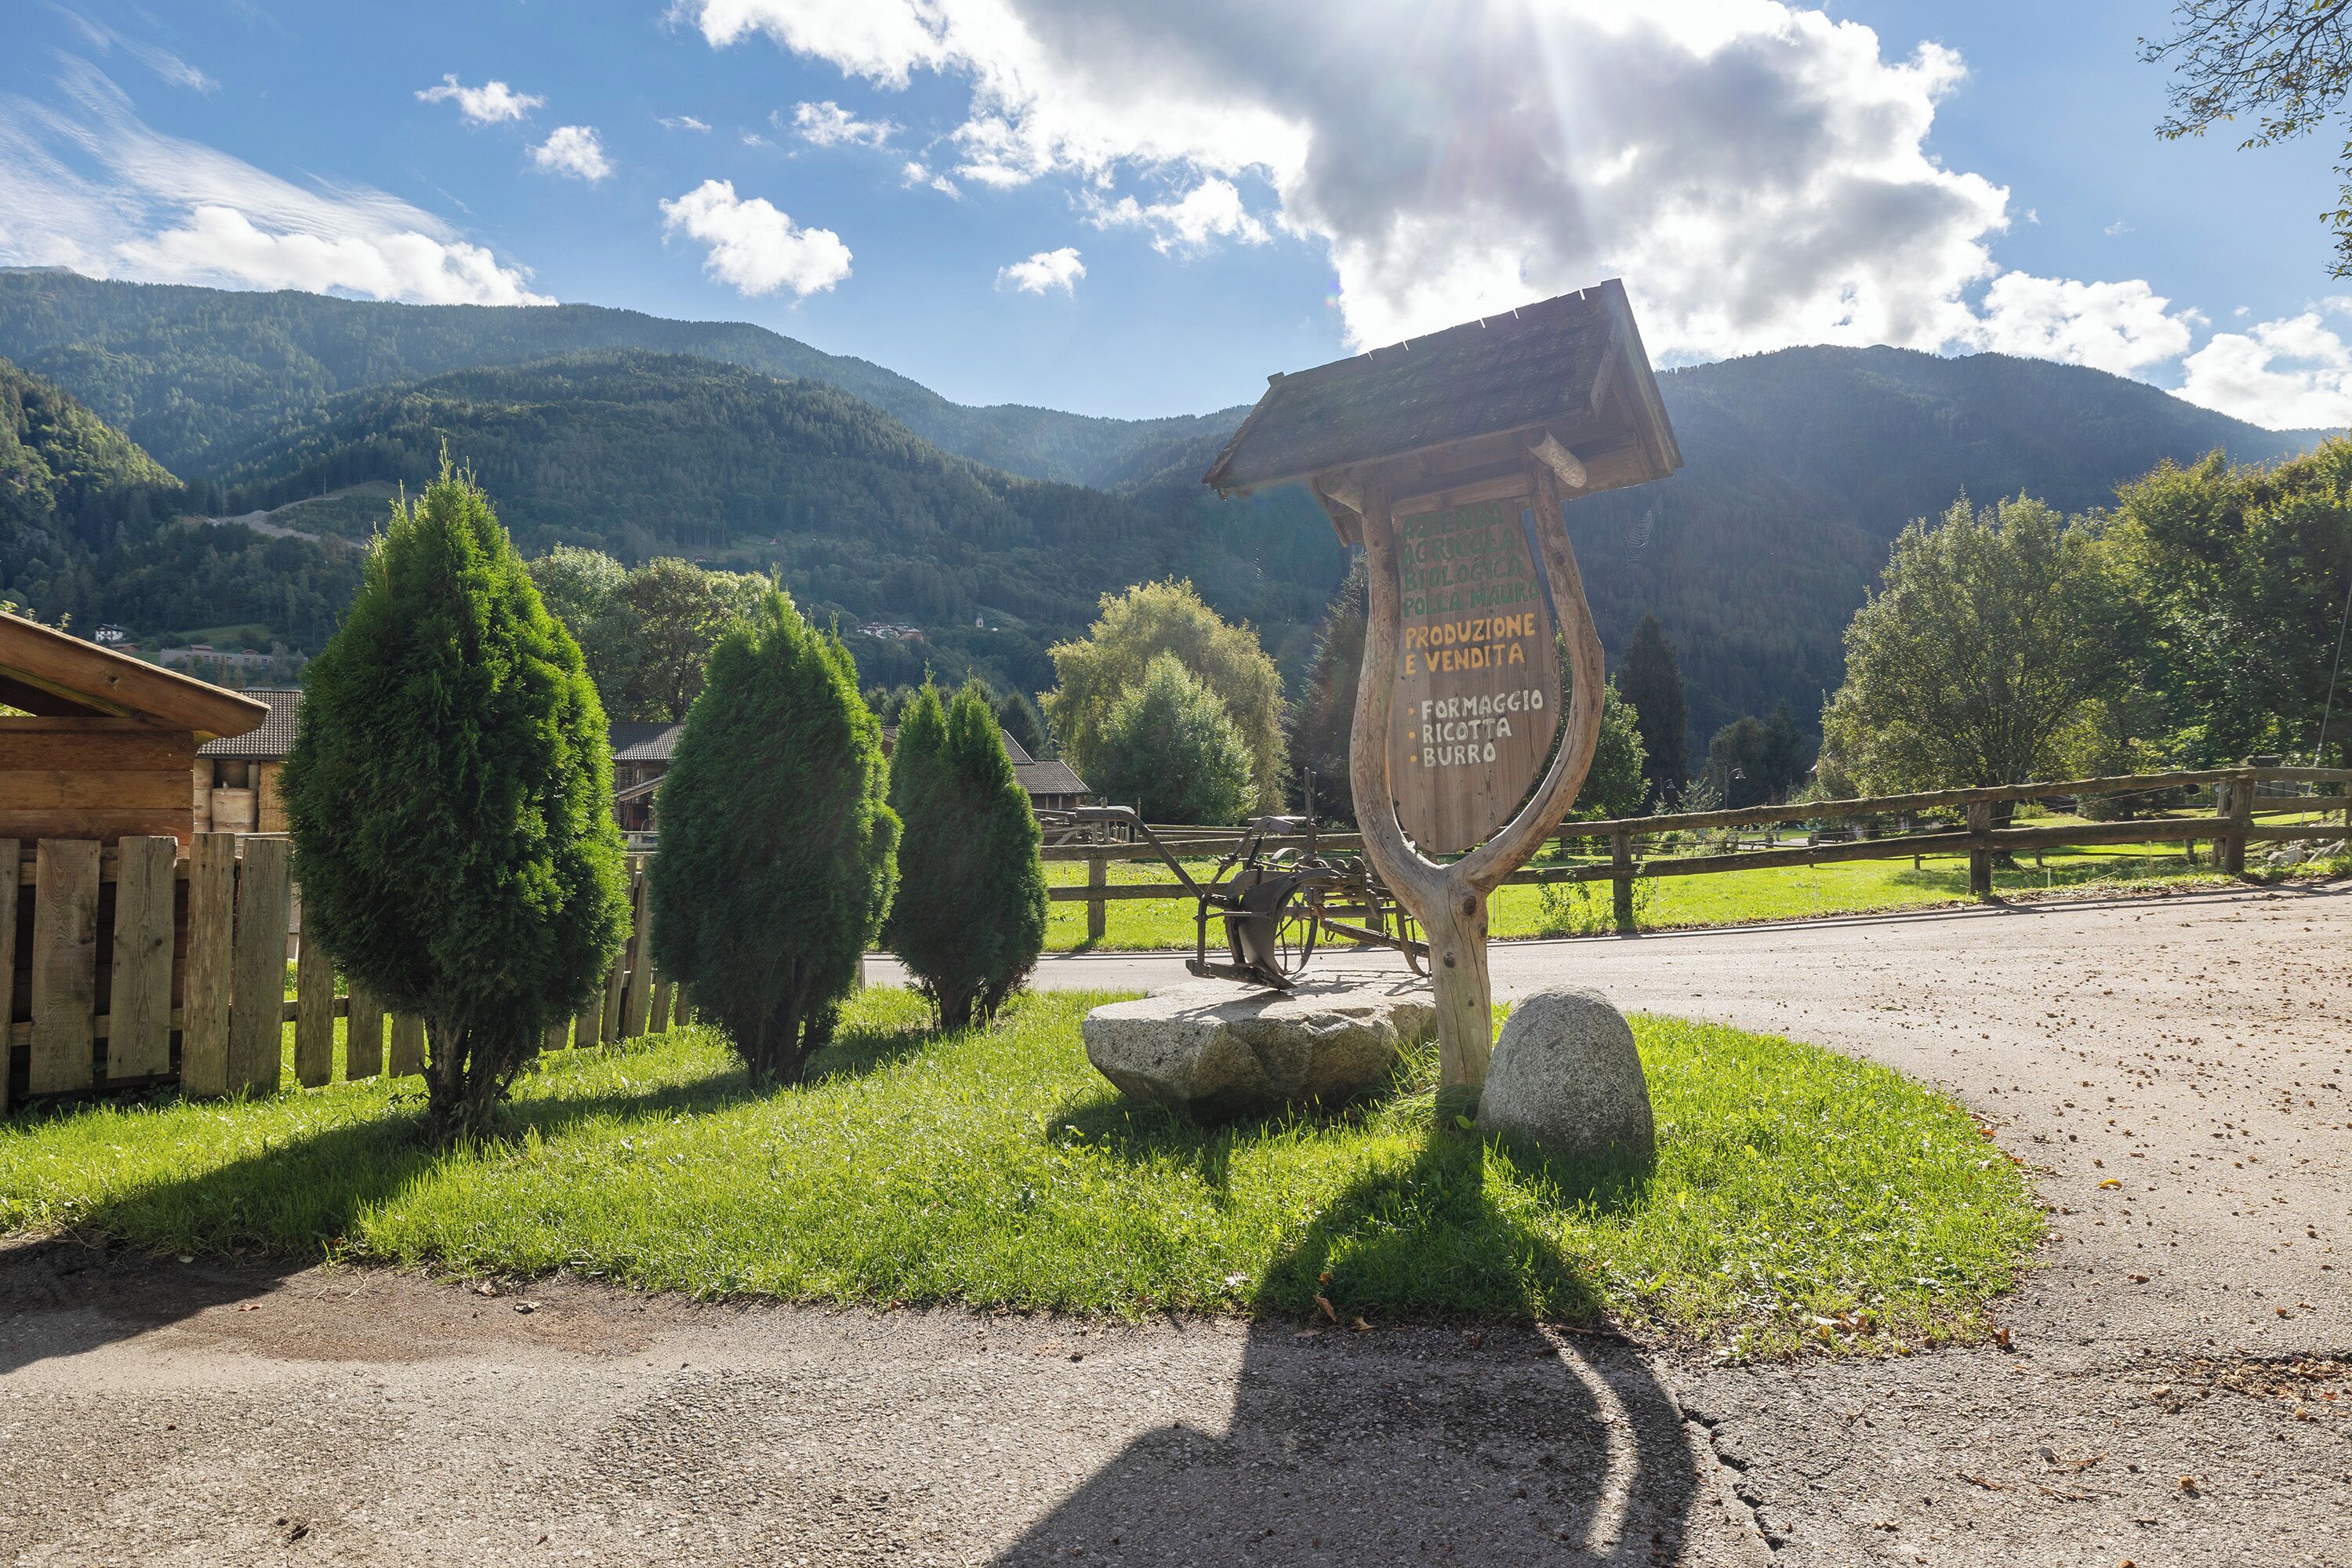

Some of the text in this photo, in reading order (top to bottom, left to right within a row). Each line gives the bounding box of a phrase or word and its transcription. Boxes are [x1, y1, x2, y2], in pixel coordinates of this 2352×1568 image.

[1400, 503, 1504, 541] AZIENDA
[1401, 527, 1518, 565] AGRICOLA
[1403, 554, 1526, 593] BIOLOGICA
[1403, 579, 1541, 619] POLLA MAURO
[1405, 613, 1535, 649] PRODUZIONE
[1405, 642, 1525, 675] E VENDITA
[1421, 689, 1544, 720] FORMAGGIO
[1422, 717, 1512, 744] RICOTTA
[1423, 742, 1496, 768] BURRO
